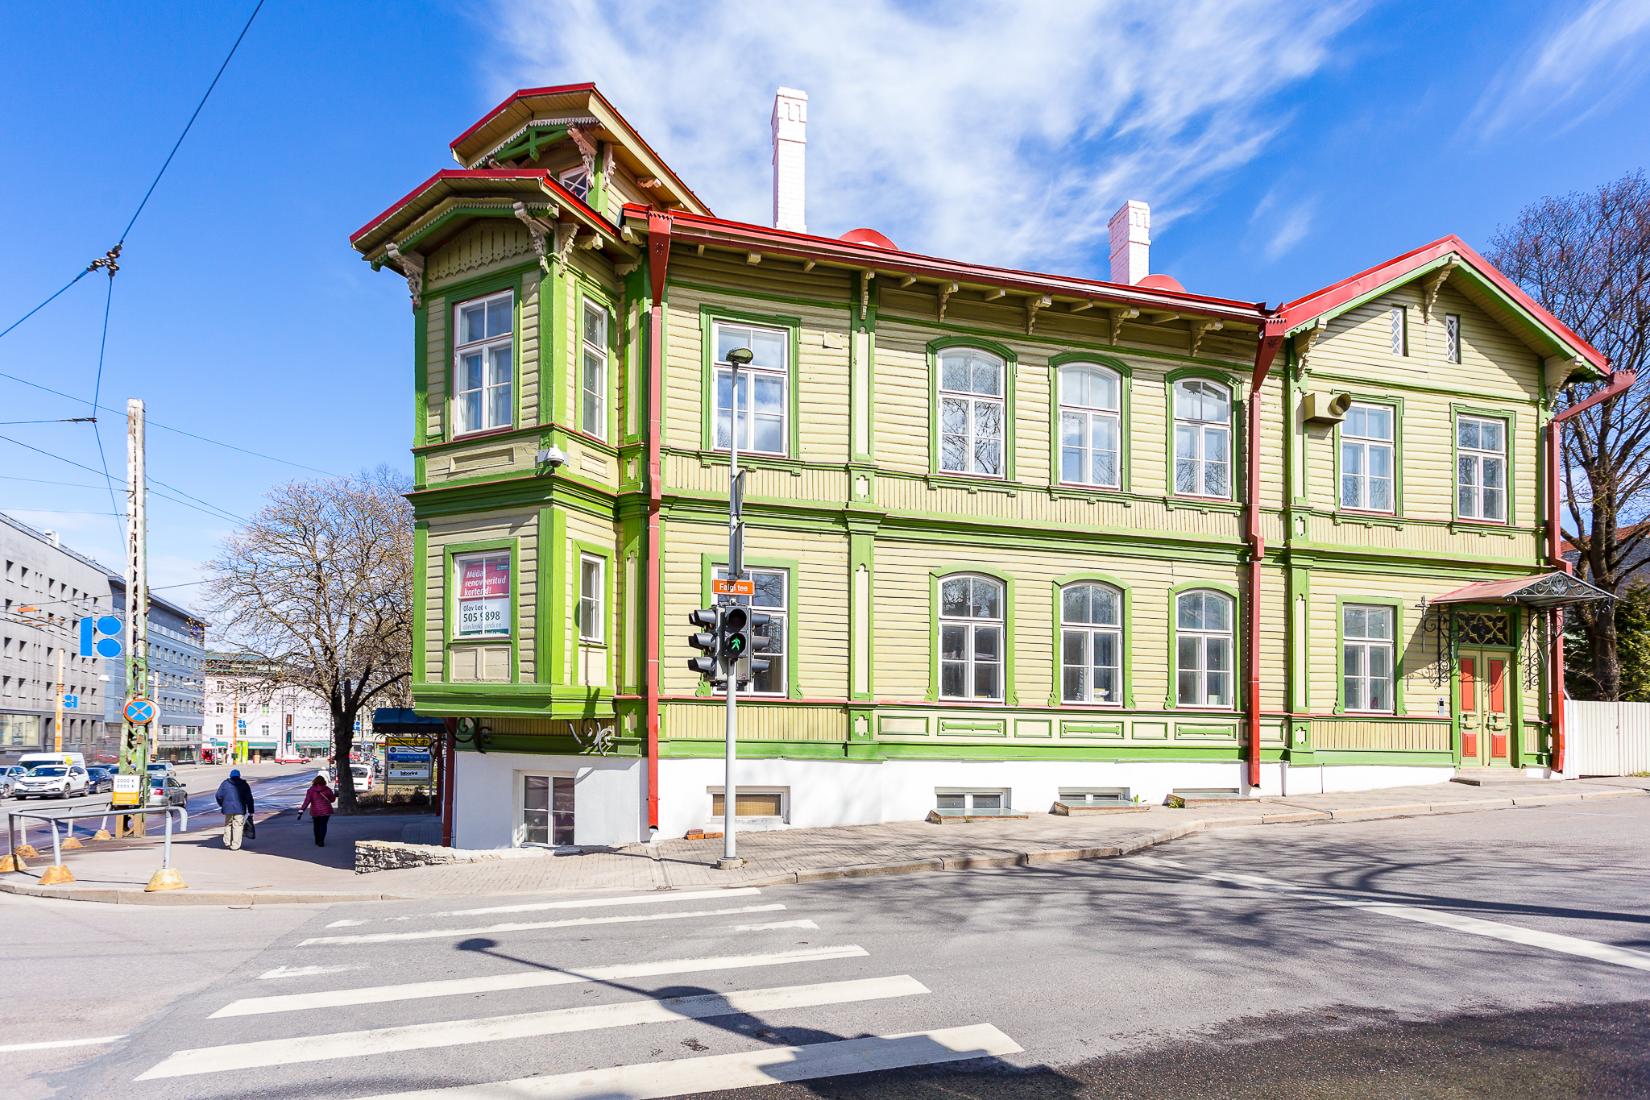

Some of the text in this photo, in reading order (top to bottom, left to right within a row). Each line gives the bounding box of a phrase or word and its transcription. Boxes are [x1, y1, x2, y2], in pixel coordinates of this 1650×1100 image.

[464, 576, 506, 587] renoveritud
[737, 584, 748, 592] tee
[463, 612, 478, 622] 505
